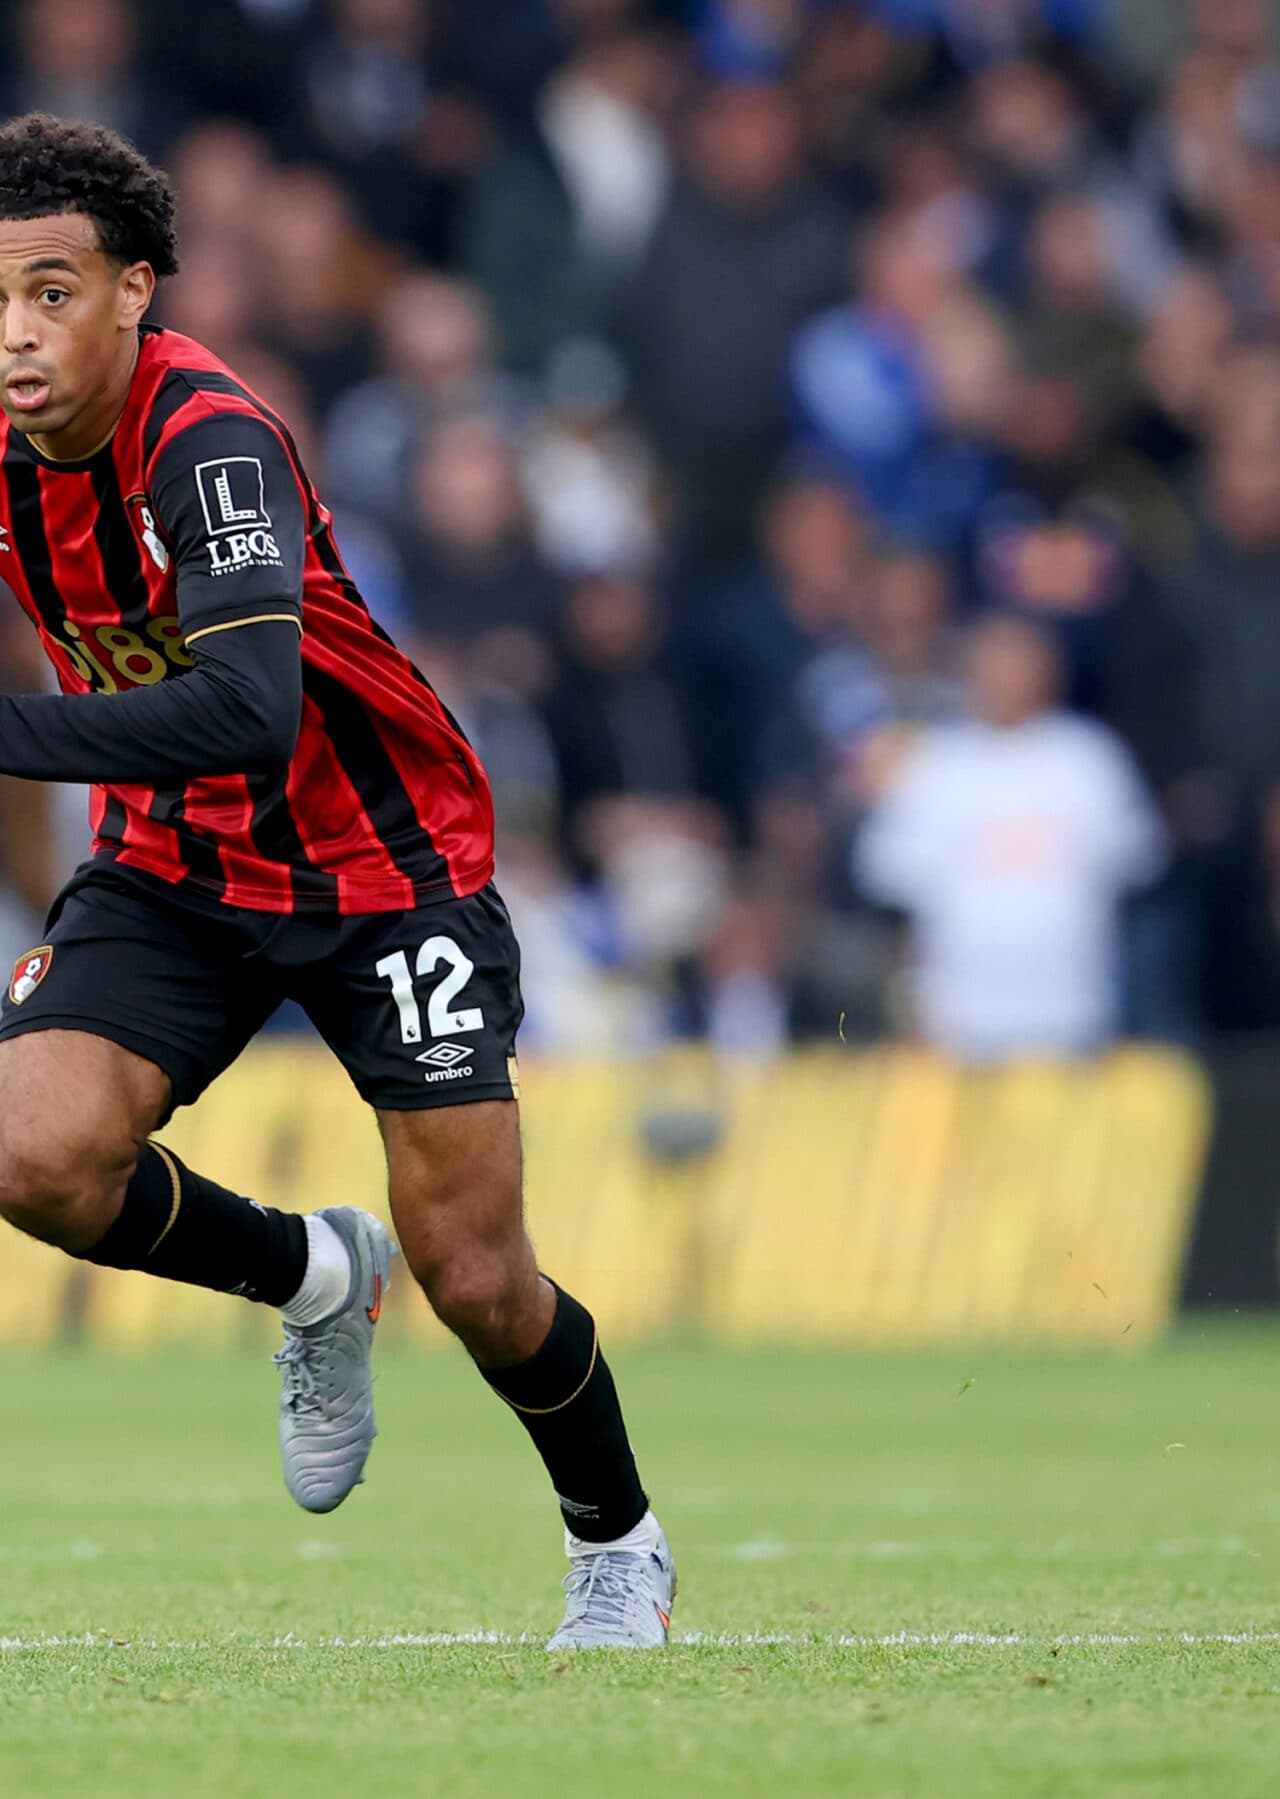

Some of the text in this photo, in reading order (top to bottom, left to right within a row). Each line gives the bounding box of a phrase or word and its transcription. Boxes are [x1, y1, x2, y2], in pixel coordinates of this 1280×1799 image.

[206, 530, 281, 569] LEOS
[375, 935, 485, 1044] 12
[424, 1065, 474, 1083] umbro
